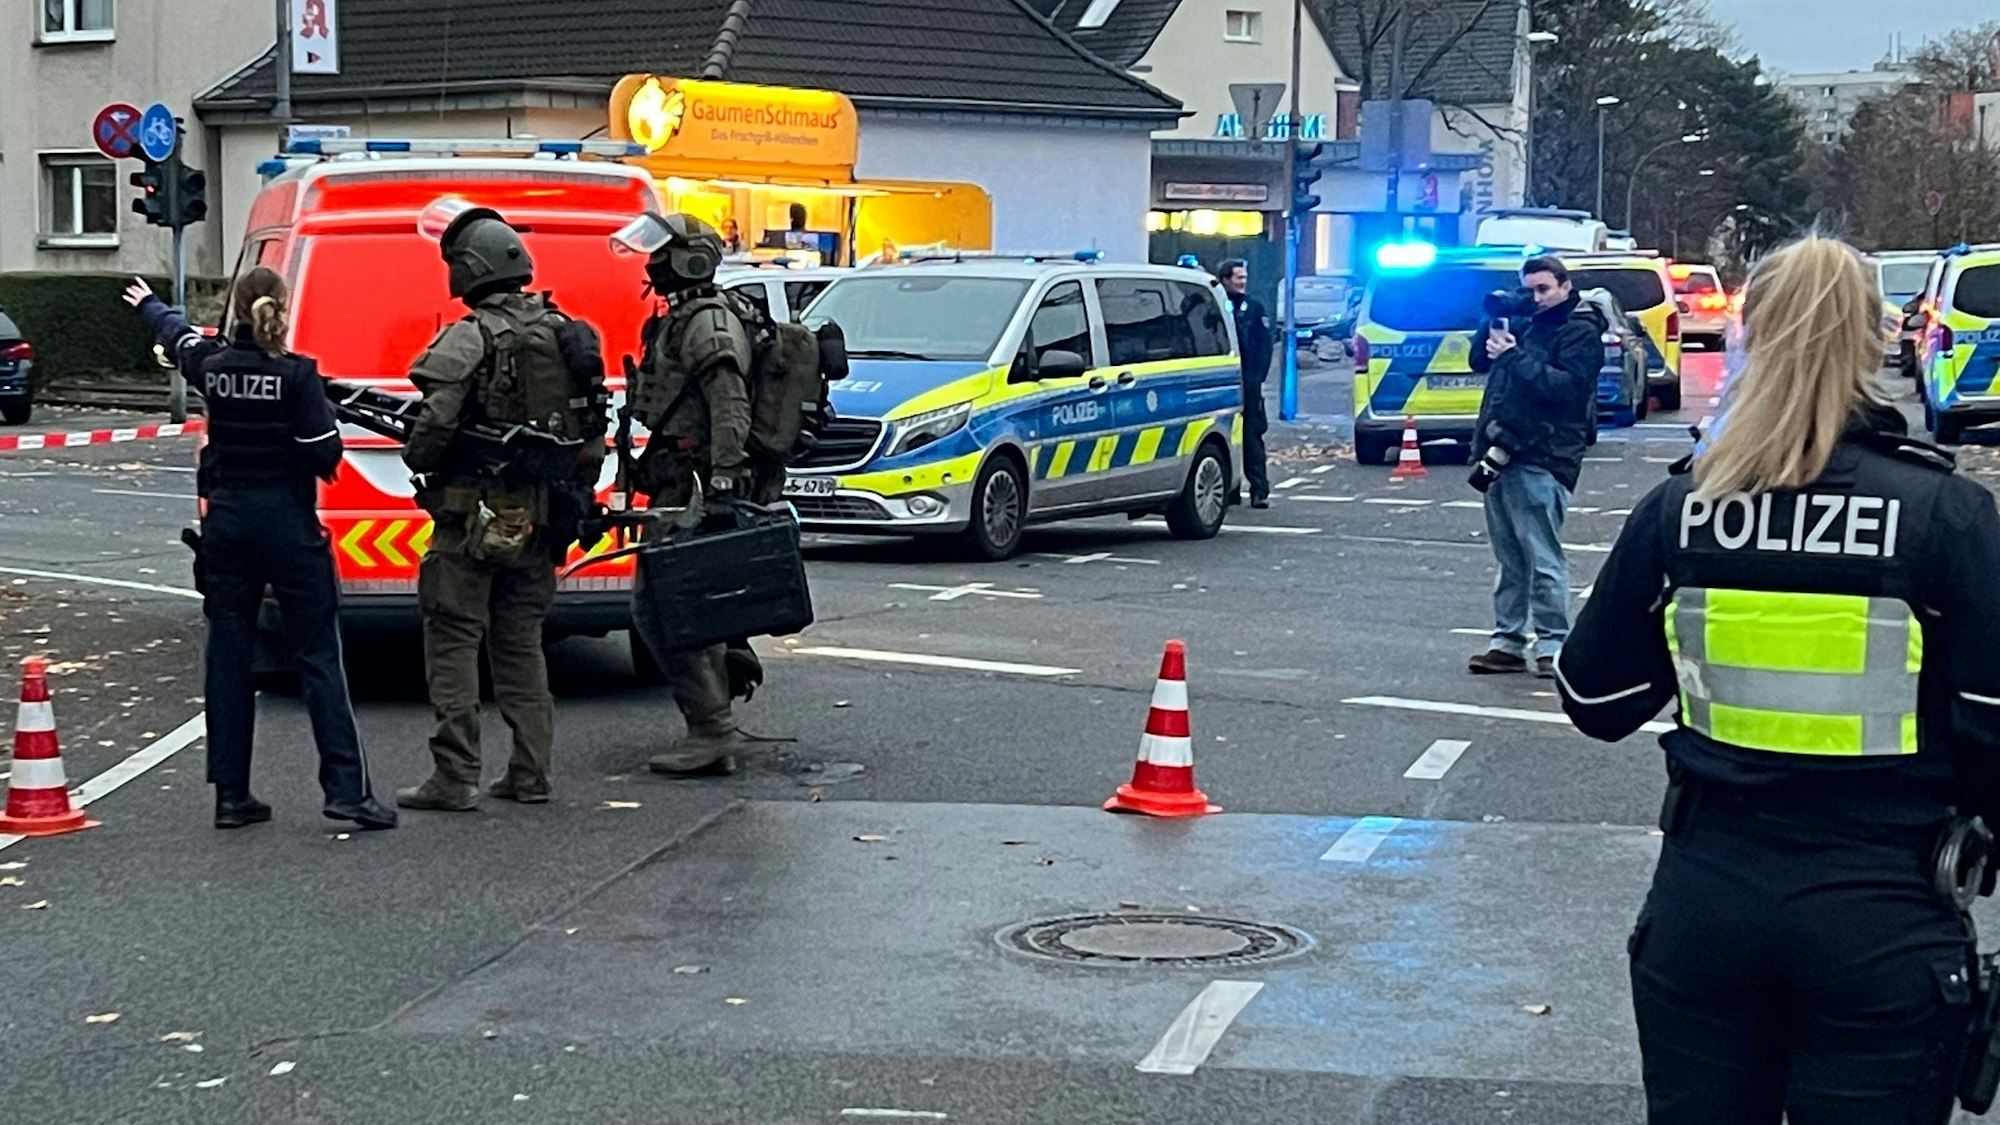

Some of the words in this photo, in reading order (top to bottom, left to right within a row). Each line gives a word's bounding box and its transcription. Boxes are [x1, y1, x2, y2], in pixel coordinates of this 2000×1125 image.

[691, 98, 839, 129] GaumenSchmaus
[1368, 344, 1433, 358] POLIZEI
[205, 371, 282, 400] POLIZEI
[1052, 400, 1098, 427] POLIZEI
[1679, 490, 1900, 558] POLIZEI
